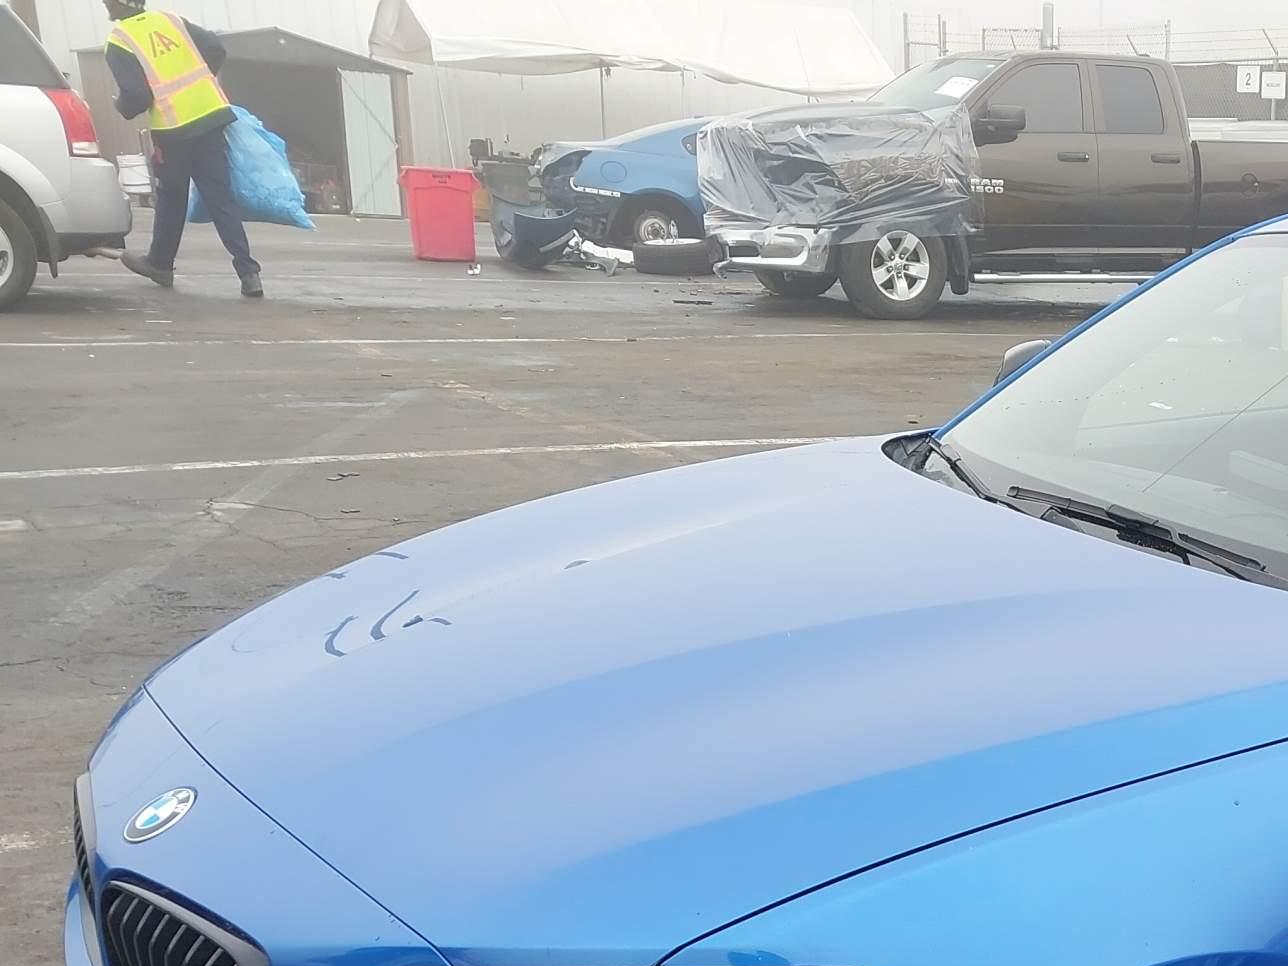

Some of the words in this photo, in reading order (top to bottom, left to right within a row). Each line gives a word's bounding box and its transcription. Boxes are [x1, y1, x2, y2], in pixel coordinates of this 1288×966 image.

[1245, 72, 1252, 86] 2
[970, 178, 1004, 186] RAM
[970, 185, 1004, 194] 1500
